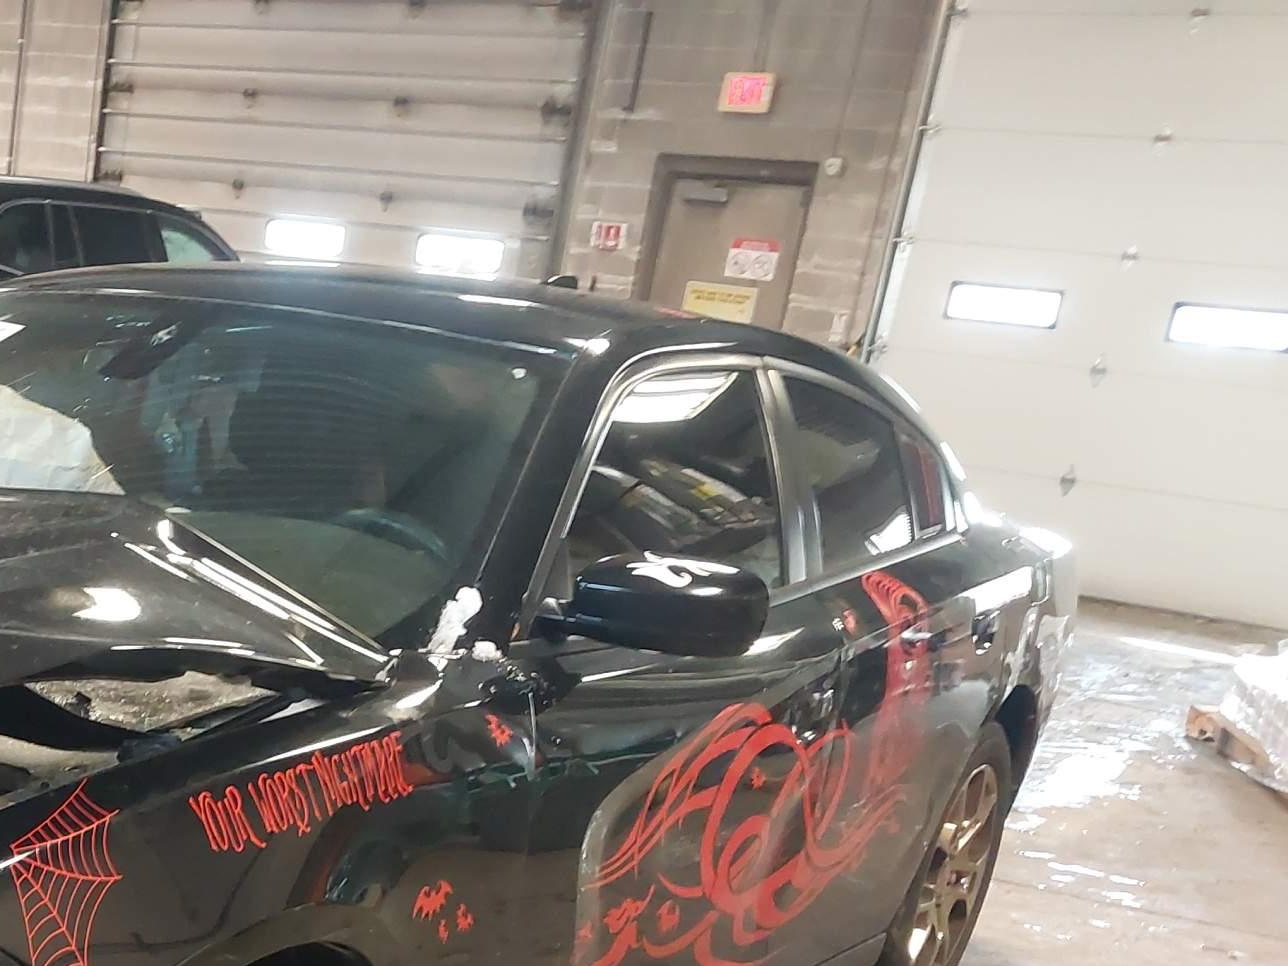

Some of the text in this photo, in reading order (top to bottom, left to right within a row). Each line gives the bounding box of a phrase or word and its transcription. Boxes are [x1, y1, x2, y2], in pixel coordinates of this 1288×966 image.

[188, 730, 414, 853] YOUR WORST NIGHTMARE
